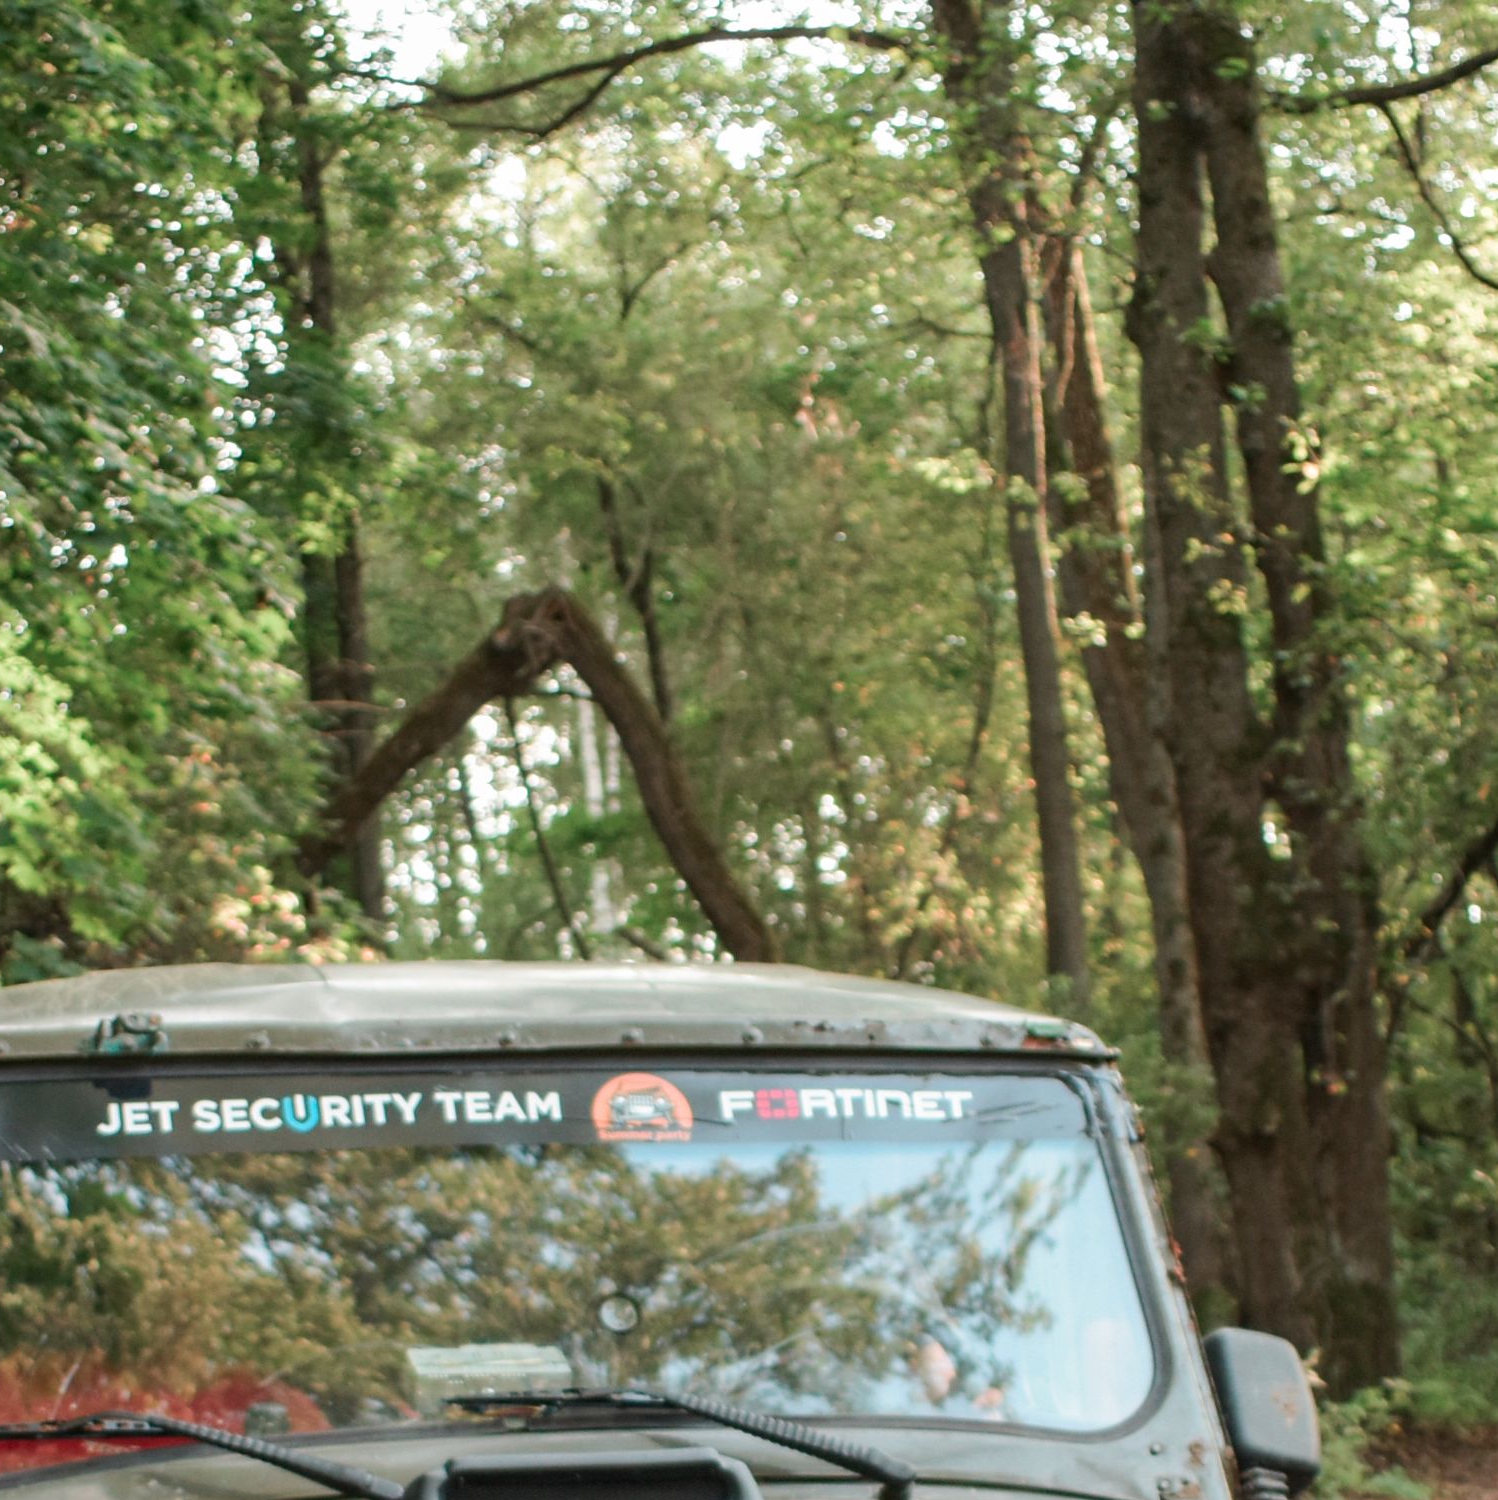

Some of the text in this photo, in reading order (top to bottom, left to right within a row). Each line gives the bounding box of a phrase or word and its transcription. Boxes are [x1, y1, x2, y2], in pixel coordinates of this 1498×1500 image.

[96, 1090, 563, 1136] JET SECURITY TEAM
[719, 1088, 974, 1120] FORTINET
